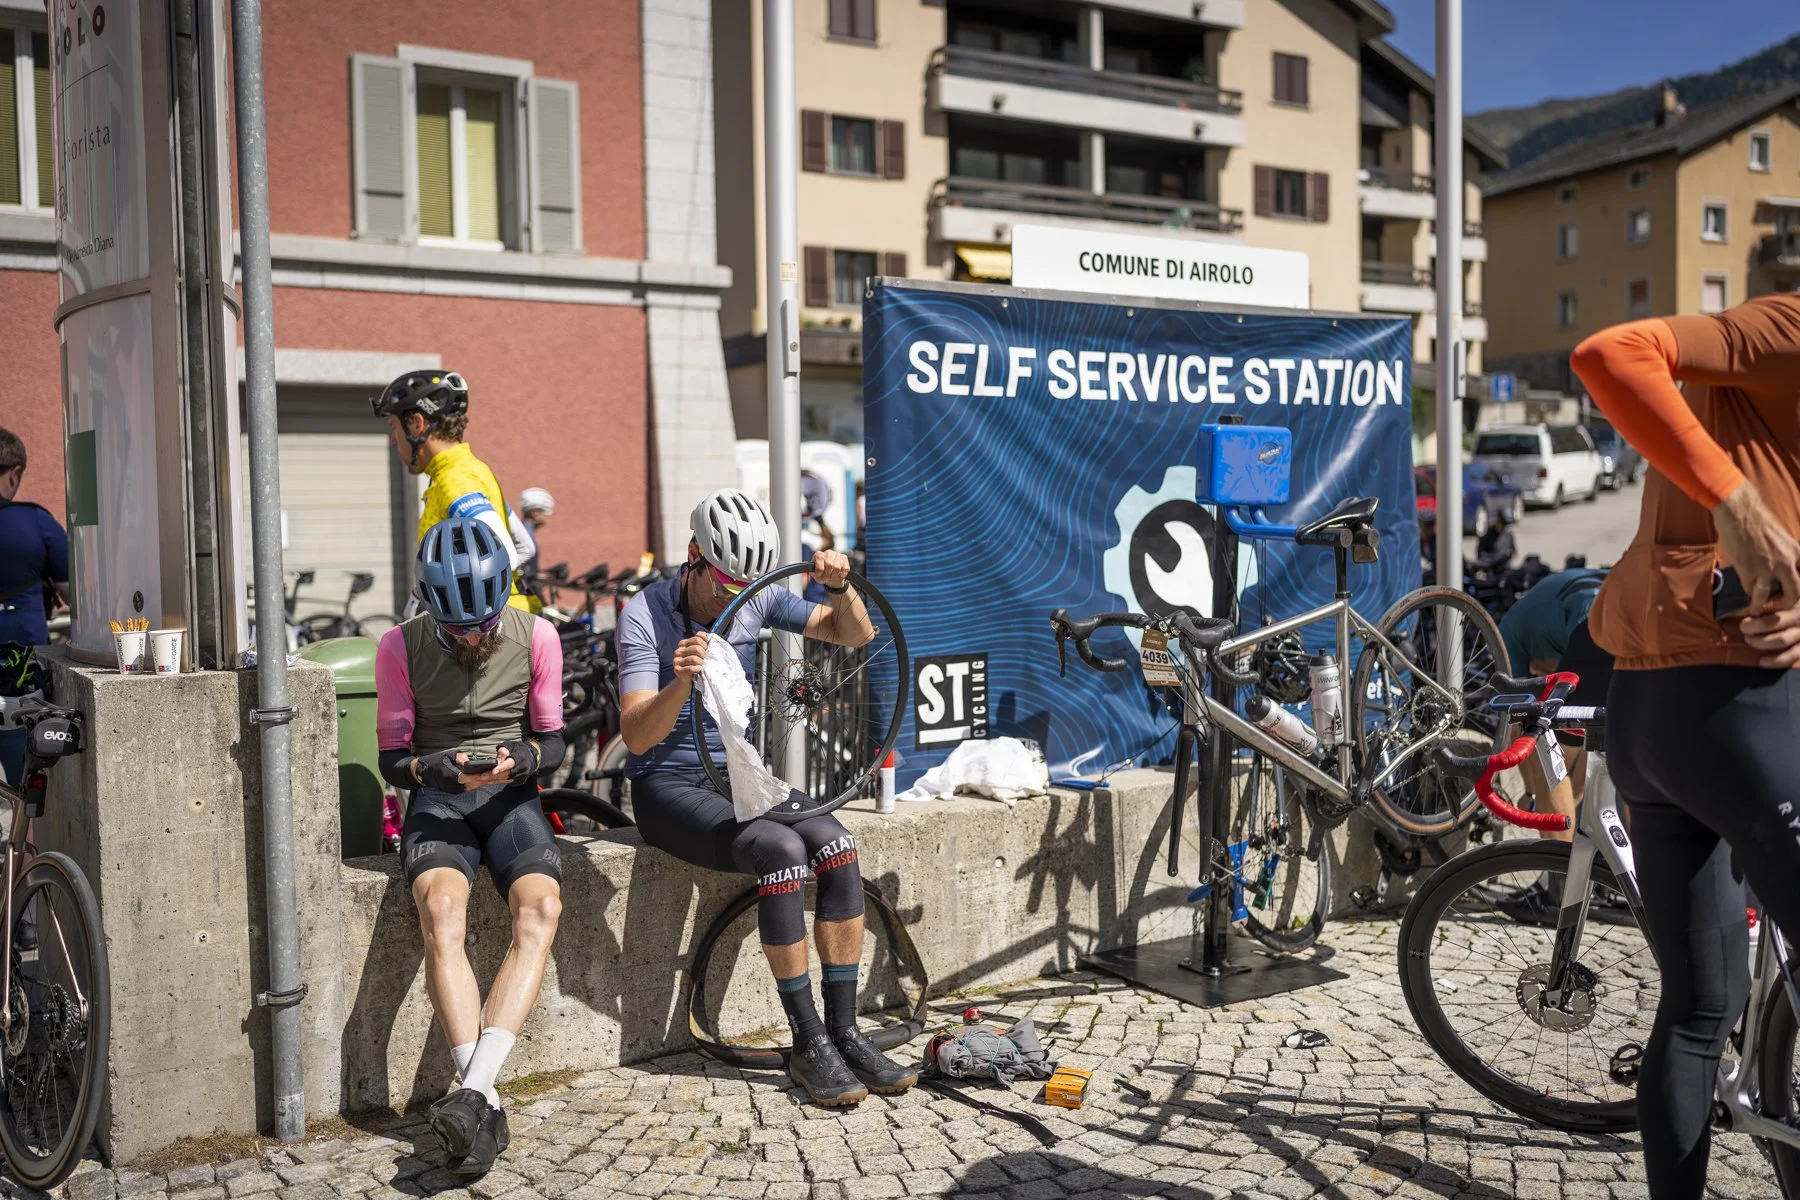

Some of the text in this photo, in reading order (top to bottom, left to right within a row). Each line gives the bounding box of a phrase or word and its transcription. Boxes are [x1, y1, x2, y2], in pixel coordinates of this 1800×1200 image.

[1079, 251, 1254, 286] COMUNE DI AIROLO
[906, 340, 1404, 407] SELF SERVICE STATION
[1142, 650, 1169, 665] 4039
[917, 662, 970, 725] ST
[972, 660, 987, 738] CYCLING
